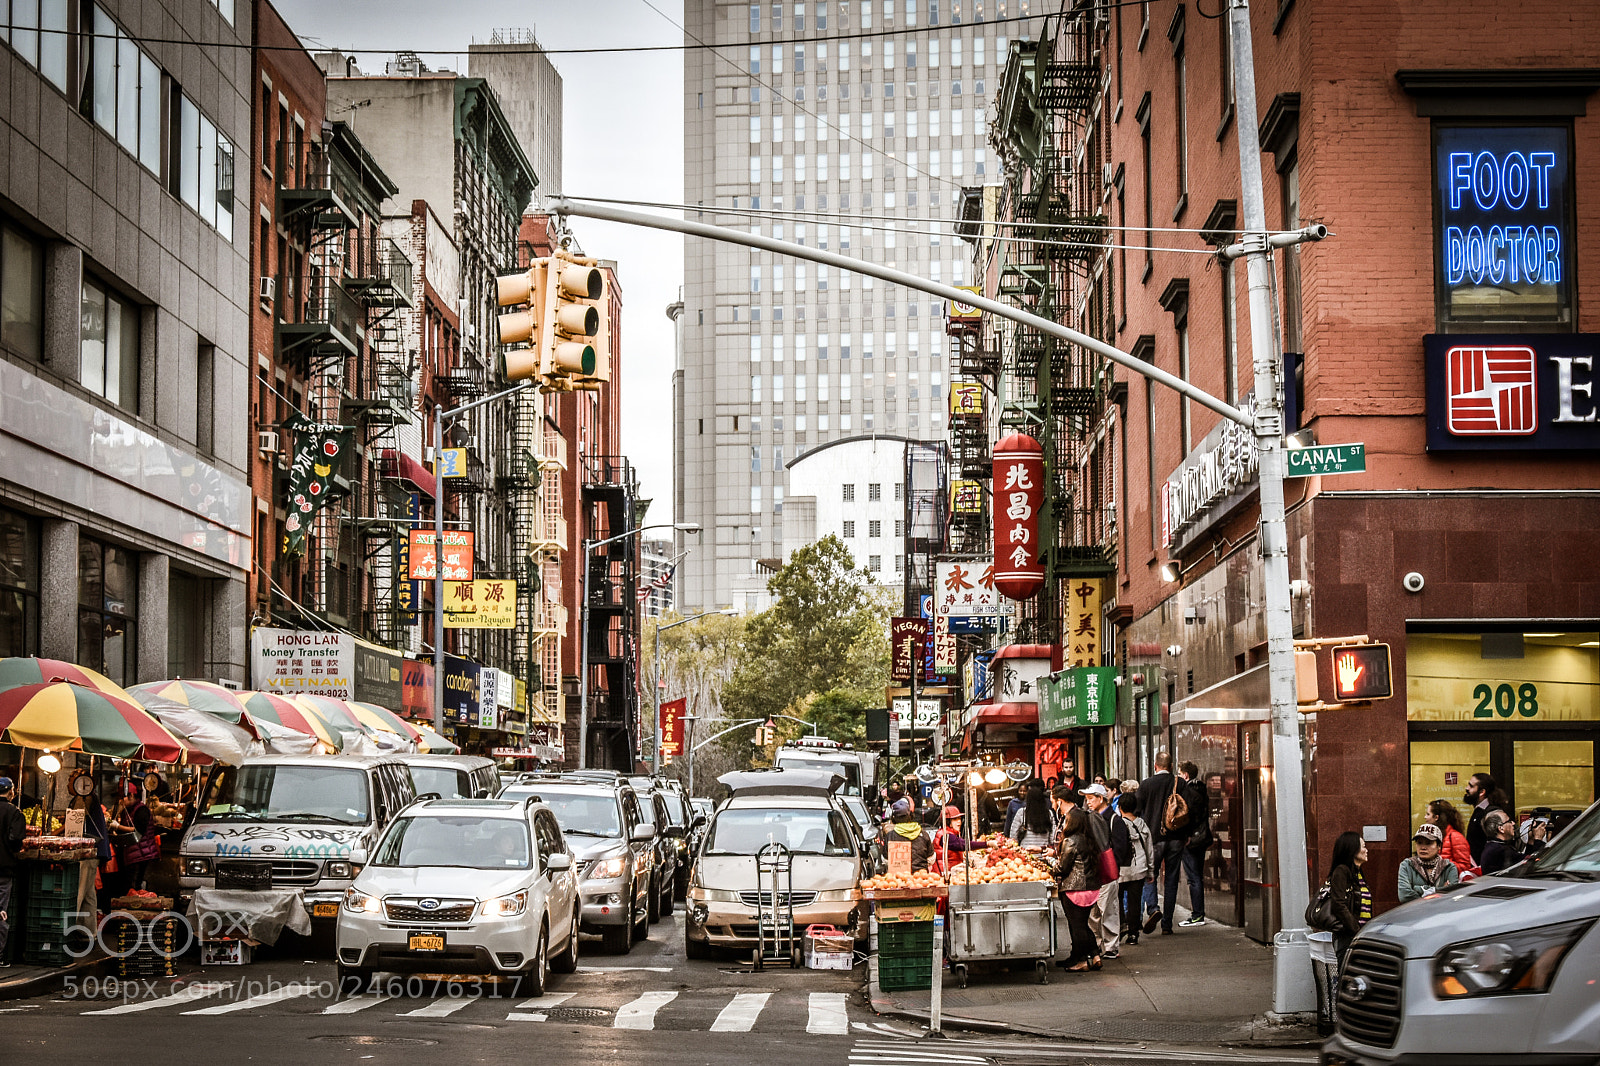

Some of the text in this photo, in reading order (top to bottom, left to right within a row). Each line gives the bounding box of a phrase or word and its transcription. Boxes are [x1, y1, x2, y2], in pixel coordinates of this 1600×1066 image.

[1449, 151, 1555, 211] FOOT
[1447, 225, 1561, 285] DOCTOR
[1290, 446, 1361, 466] CANAL ST
[1004, 463, 1034, 569] 兆昌肉食
[453, 582, 505, 602] 順源
[893, 621, 926, 634] VEGAN
[277, 635, 339, 645] HONG LAN
[262, 648, 340, 658] Money Transfer
[266, 678, 347, 687] VIETNAM
[1473, 683, 1539, 718] 208
